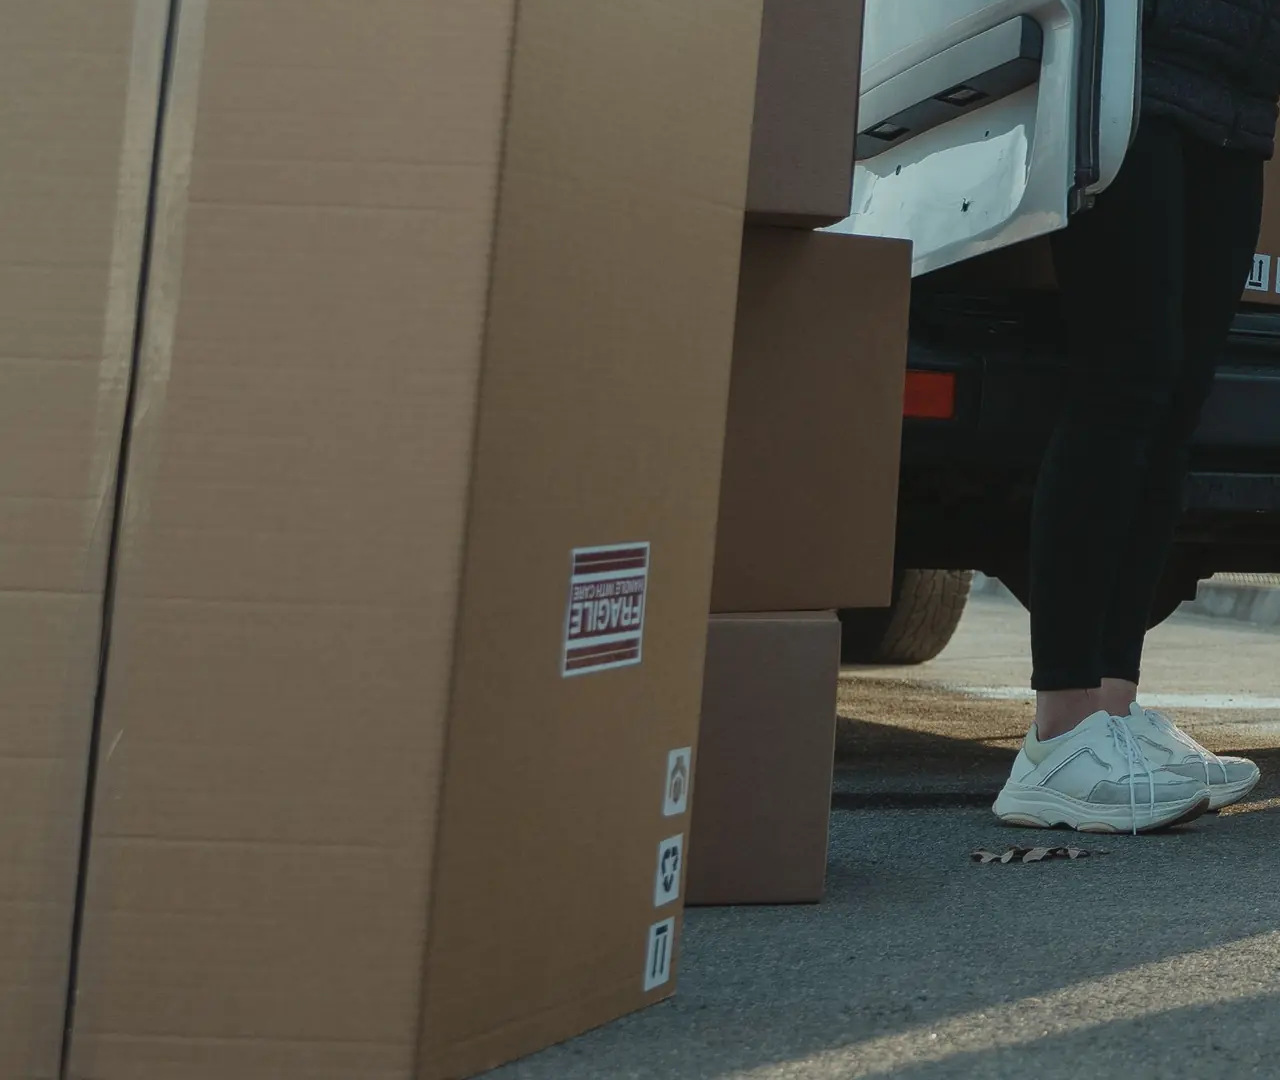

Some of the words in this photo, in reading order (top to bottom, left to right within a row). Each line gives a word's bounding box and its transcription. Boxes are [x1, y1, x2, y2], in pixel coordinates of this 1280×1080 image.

[573, 584, 595, 600] CARE
[595, 583, 615, 598] WITH
[569, 595, 641, 635] FRAGILE
